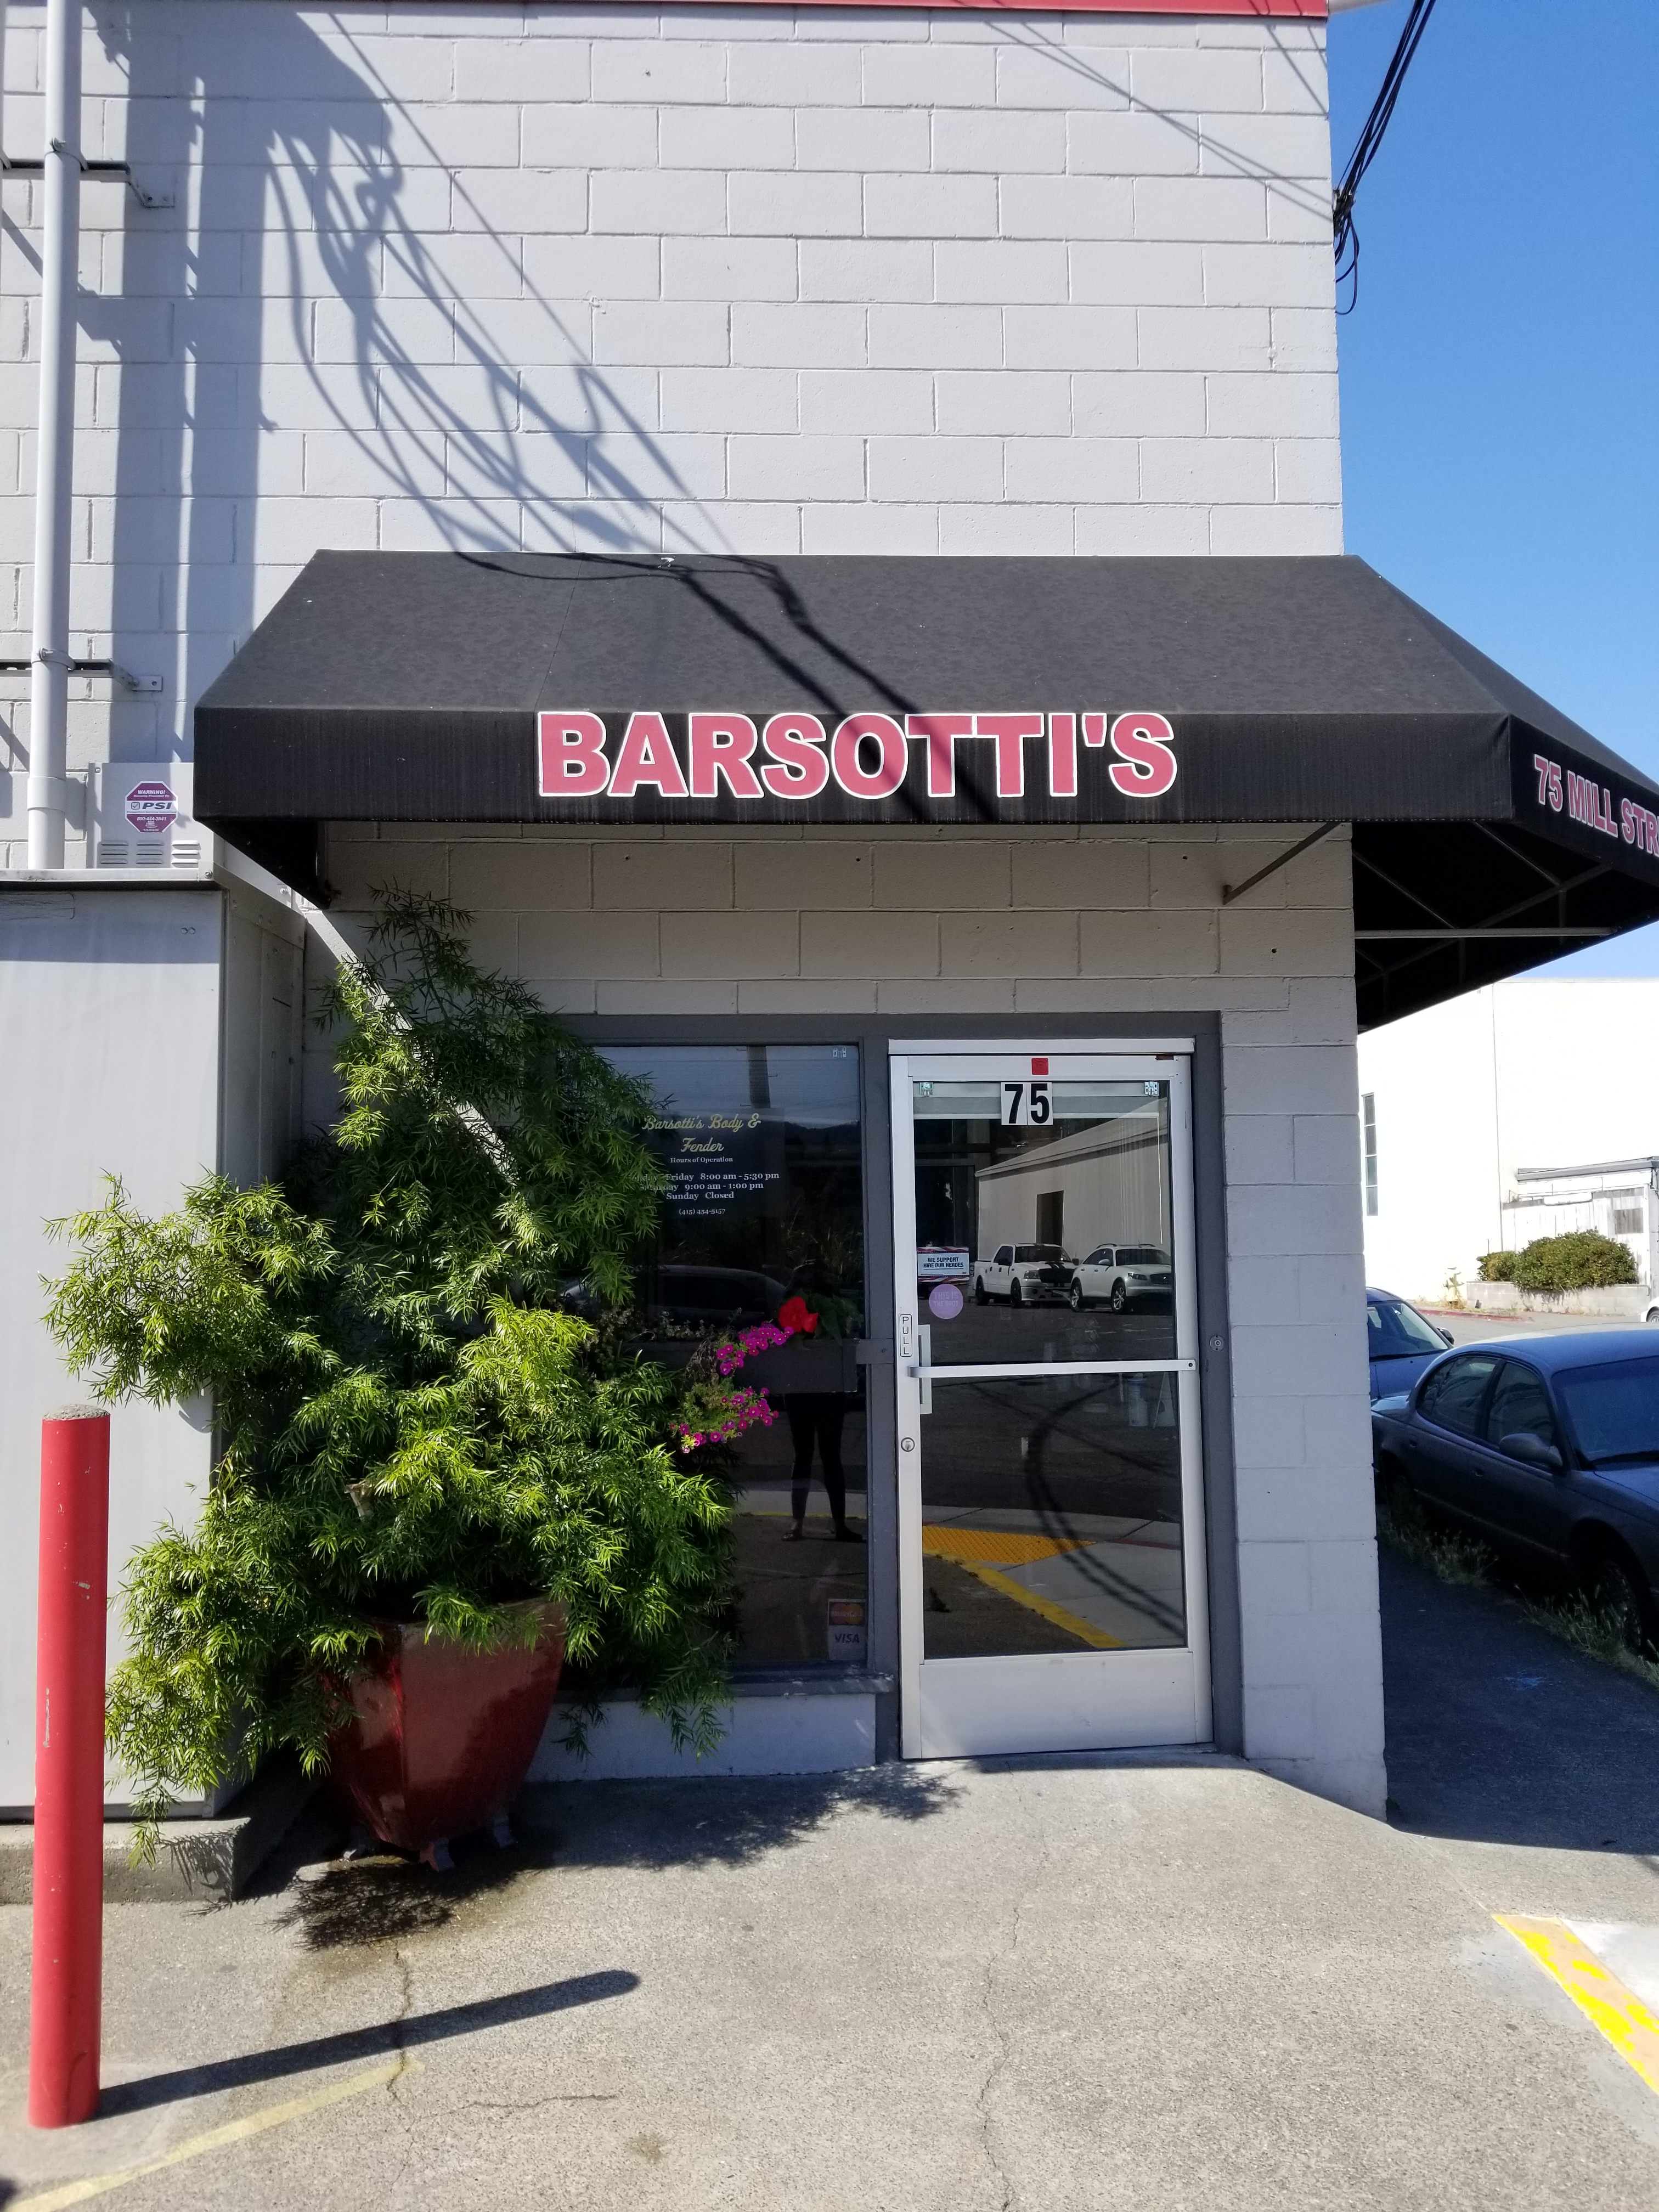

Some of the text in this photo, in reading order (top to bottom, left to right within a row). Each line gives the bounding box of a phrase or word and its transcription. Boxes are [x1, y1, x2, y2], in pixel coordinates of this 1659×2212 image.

[537, 711, 1178, 799] BARSOTTI'S
[1534, 753, 1659, 857] 75 MILL STR
[1005, 1083, 1049, 1124] 75
[642, 1113, 761, 1132] Barsotti's Body &
[681, 1137, 724, 1152] Fender
[665, 1173, 694, 1182] Friday
[666, 1191, 735, 1200] Sunday Closed
[933, 1291, 950, 1300] THIS
[834, 1633, 860, 1643] VISA
